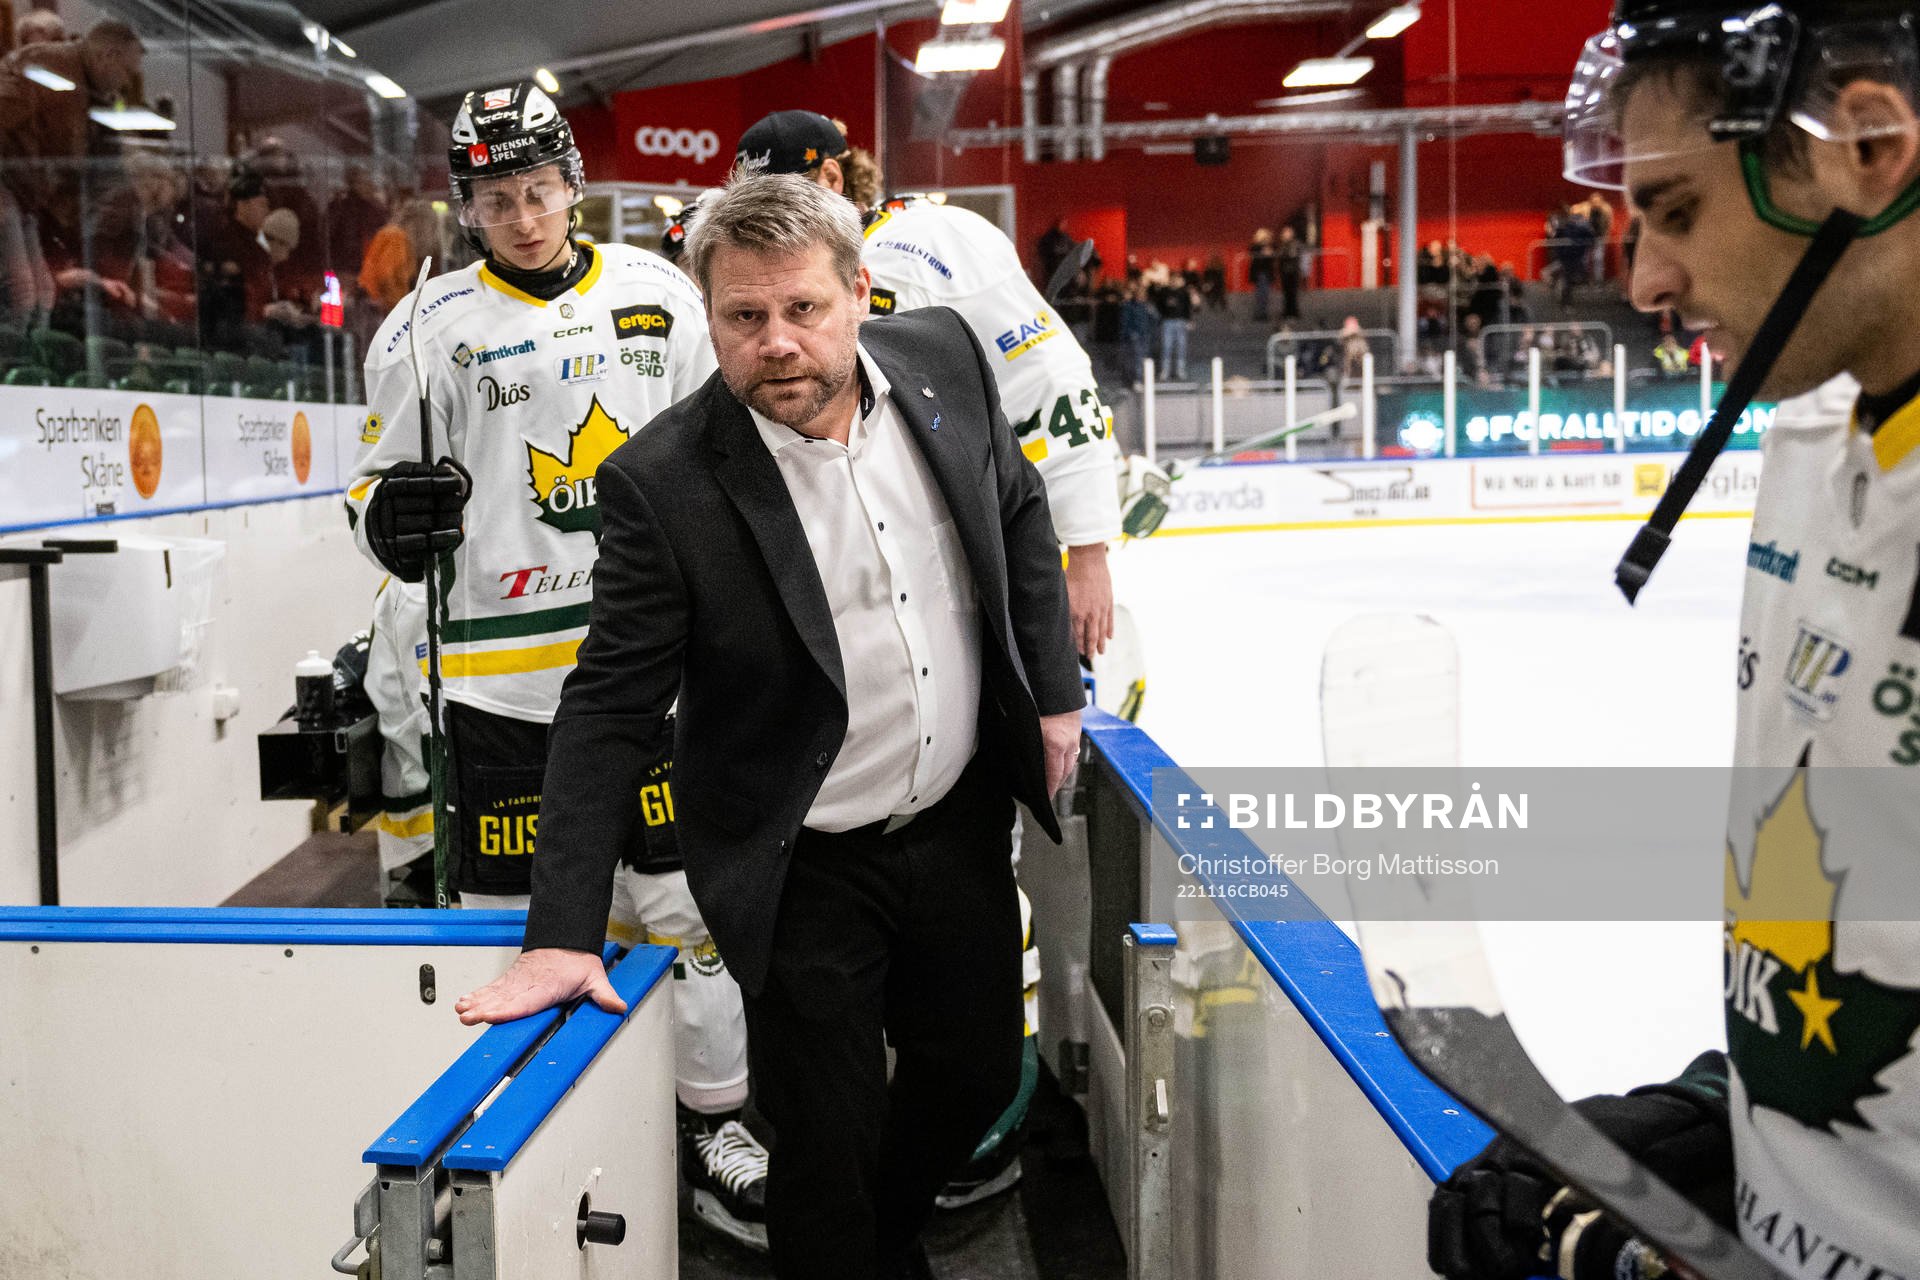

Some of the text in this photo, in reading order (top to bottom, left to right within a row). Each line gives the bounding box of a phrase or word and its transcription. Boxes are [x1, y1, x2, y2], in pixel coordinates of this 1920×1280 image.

[490, 136, 536, 154] SVENSKA
[492, 150, 517, 163] SPEL
[635, 127, 719, 163] coop
[553, 325, 593, 339] CCM
[476, 340, 536, 366] Jämtkraft
[477, 376, 531, 411] Diös
[36, 408, 122, 451] Sparbanken
[1048, 388, 1106, 449] 43
[81, 452, 124, 489] Skåne
